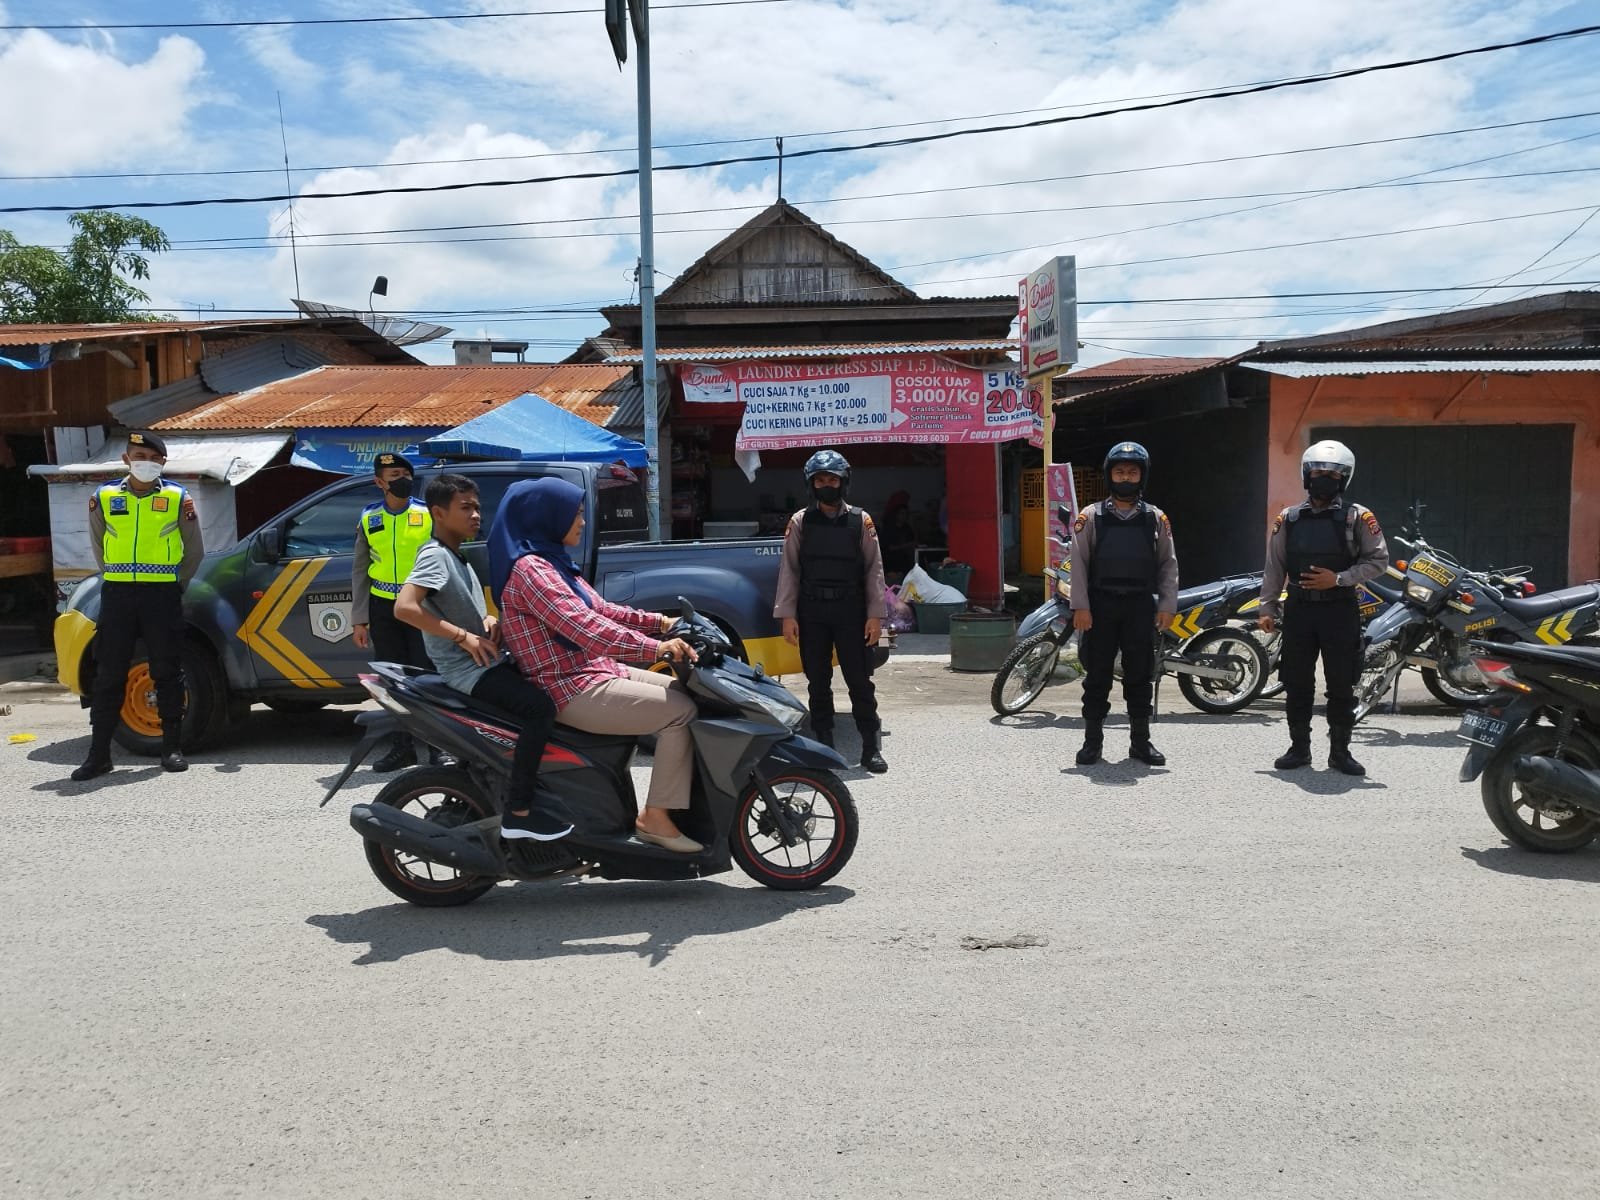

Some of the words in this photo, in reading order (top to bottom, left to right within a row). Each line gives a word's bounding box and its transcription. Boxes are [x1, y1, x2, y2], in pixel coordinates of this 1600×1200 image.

[738, 364, 802, 380] LAUNDRY
[807, 360, 868, 377] EXPRESS
[870, 359, 903, 373] SIAP
[907, 359, 926, 373] 1,5
[930, 358, 958, 374] JAM
[895, 376, 941, 387] GOSOK
[944, 377, 971, 387] UAP
[988, 372, 999, 388] 5
[1004, 370, 1025, 389] Kg
[744, 387, 765, 398] CUCI
[767, 386, 788, 397] SAJA
[789, 386, 795, 397] 7
[797, 385, 809, 398] Kg
[819, 382, 850, 395] 10.000
[895, 388, 980, 406] 3.000/Kg
[745, 401, 804, 414] CUCI+KERING
[806, 401, 812, 412] 7
[814, 400, 826, 412] Kg
[835, 397, 867, 410] 20.000
[745, 418, 767, 430] CUCI
[769, 417, 802, 429] KERING
[804, 416, 827, 428] LIPAT
[829, 415, 835, 426] 7
[837, 415, 849, 427] Kg
[857, 412, 887, 425] 25.000
[910, 413, 944, 421] Softener
[987, 414, 1009, 423] CUCI
[750, 440, 780, 449] GRATIS
[909, 434, 929, 442] 7328
[930, 434, 950, 442] 6030
[969, 430, 991, 440] CUCI
[754, 547, 783, 556] CALL
[308, 593, 352, 603] SABHARA
[1464, 616, 1496, 632] POLISI
